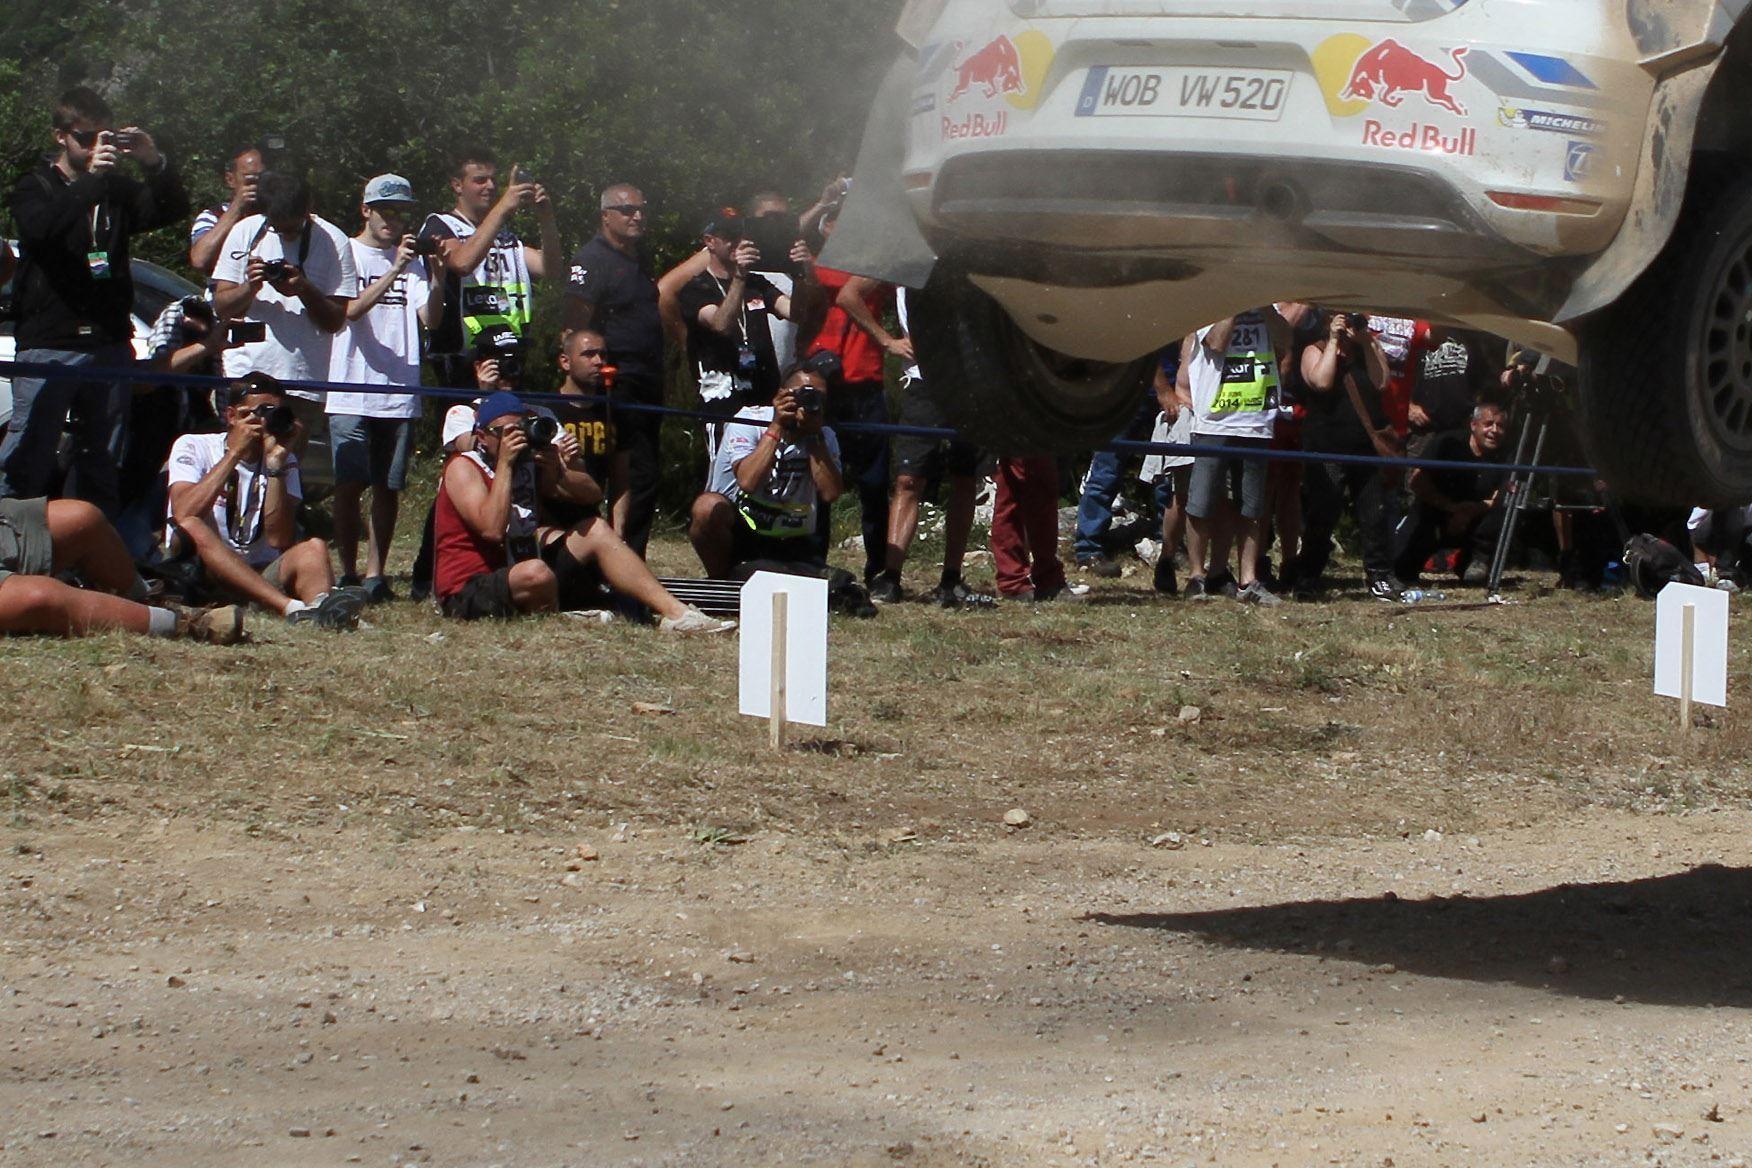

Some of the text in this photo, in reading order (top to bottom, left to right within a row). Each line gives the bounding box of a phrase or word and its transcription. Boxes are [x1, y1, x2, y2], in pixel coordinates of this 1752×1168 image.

[1103, 74, 1162, 107] WOB
[941, 110, 1009, 140] Red Bull
[1362, 119, 1476, 156] Red Bull
[1231, 328, 1260, 347] 281
